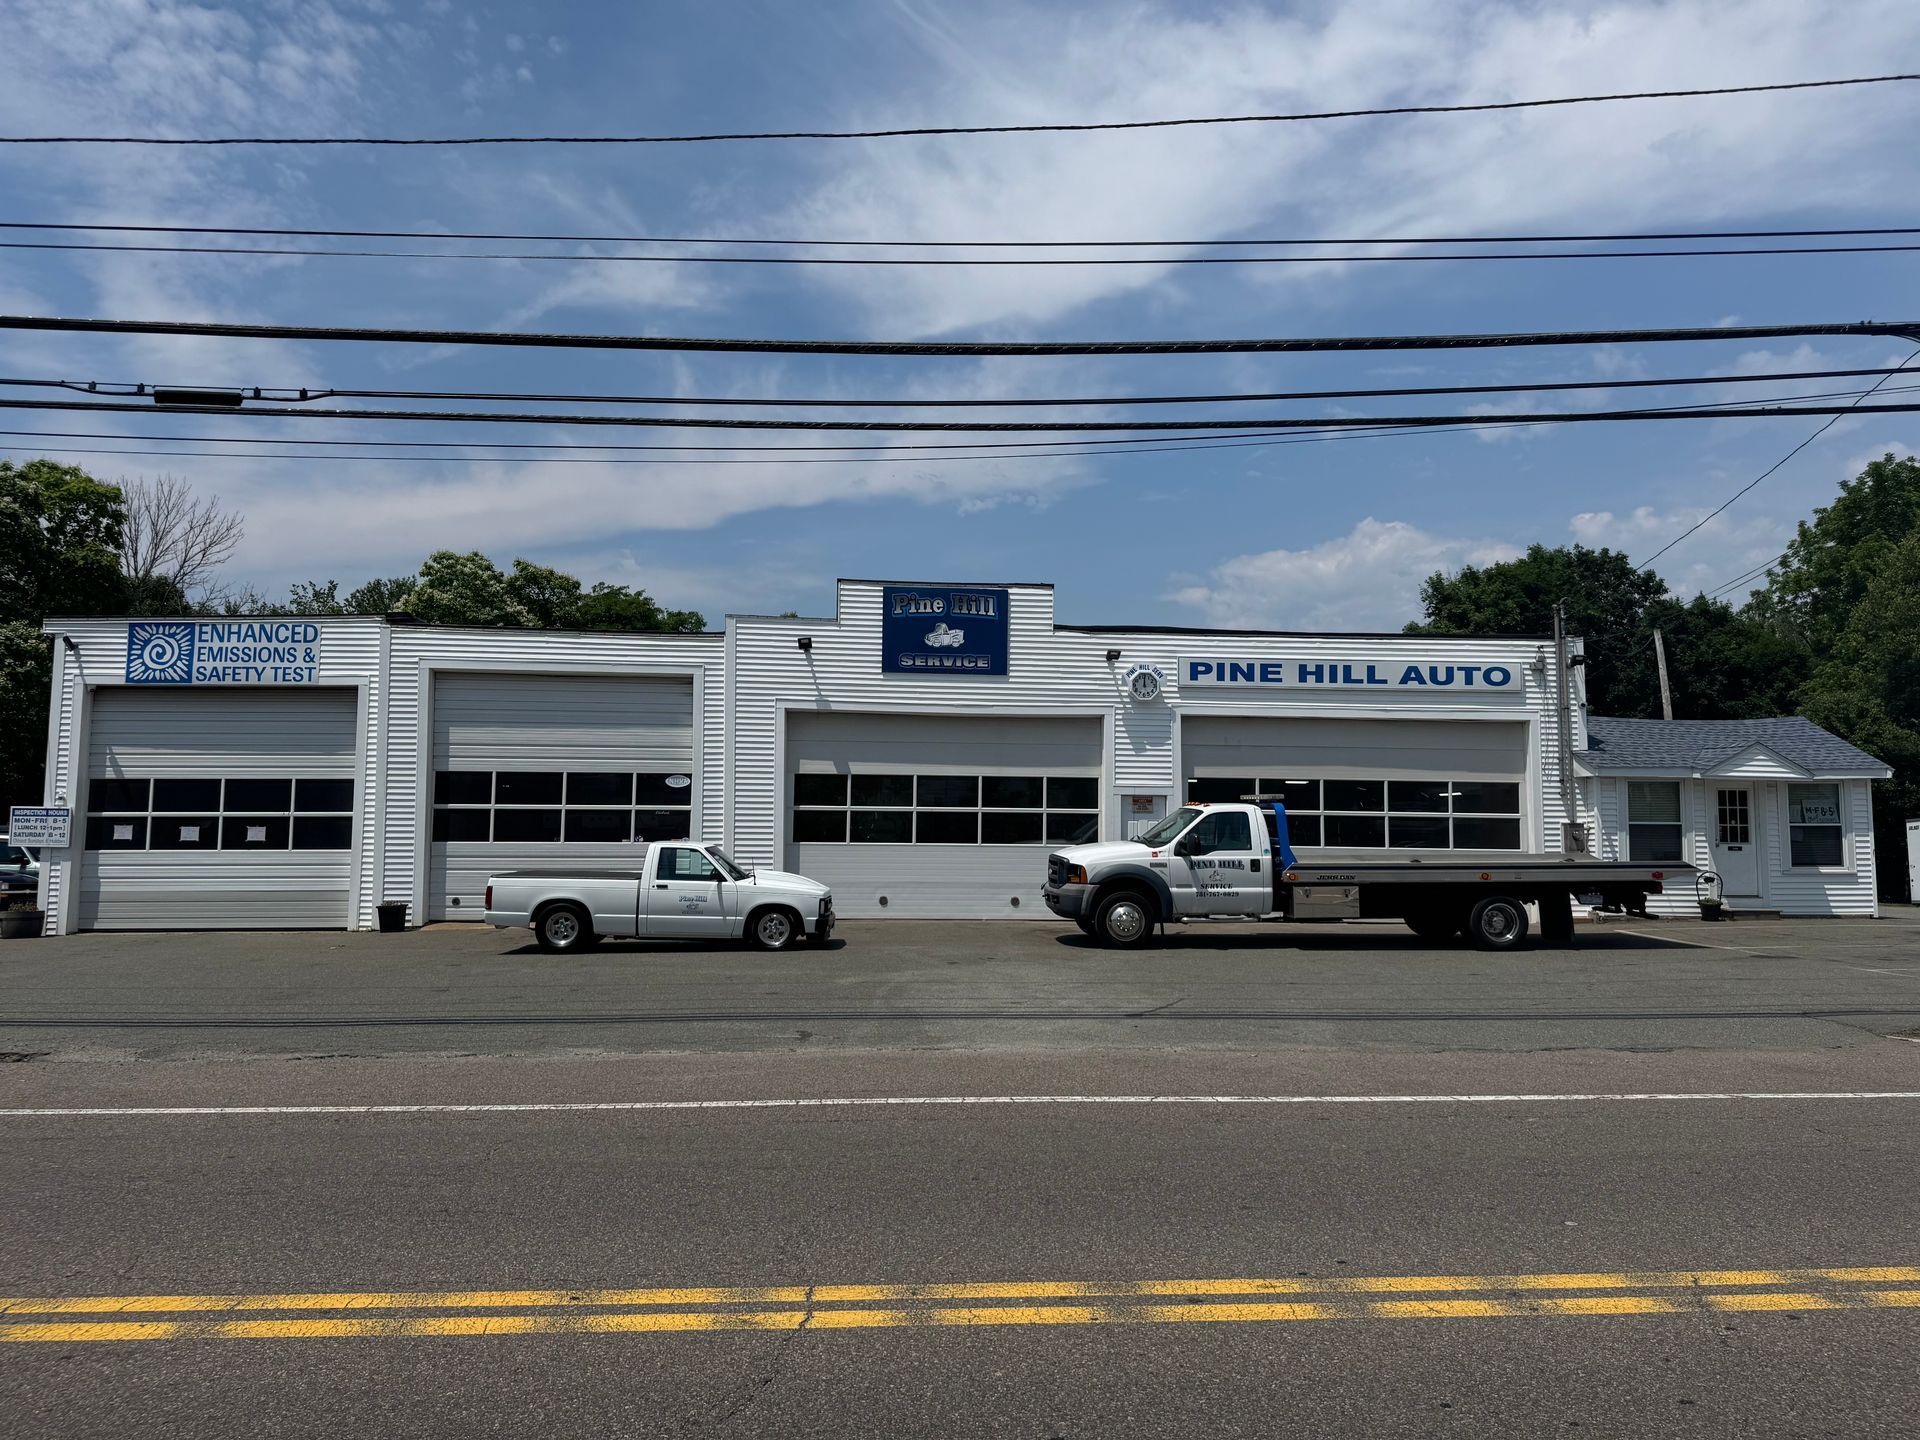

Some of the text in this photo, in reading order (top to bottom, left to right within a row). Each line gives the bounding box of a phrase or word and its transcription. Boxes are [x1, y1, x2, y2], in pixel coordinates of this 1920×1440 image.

[892, 593, 996, 617] Pine Hill
[198, 624, 318, 643] ENHANCED
[197, 646, 316, 663] EMISSIONS &
[899, 654, 989, 668] SERVICE
[195, 666, 317, 682] SAFETY TEST
[1125, 667, 1138, 679] PINE
[1189, 661, 1511, 687] PINE HILL AUTO
